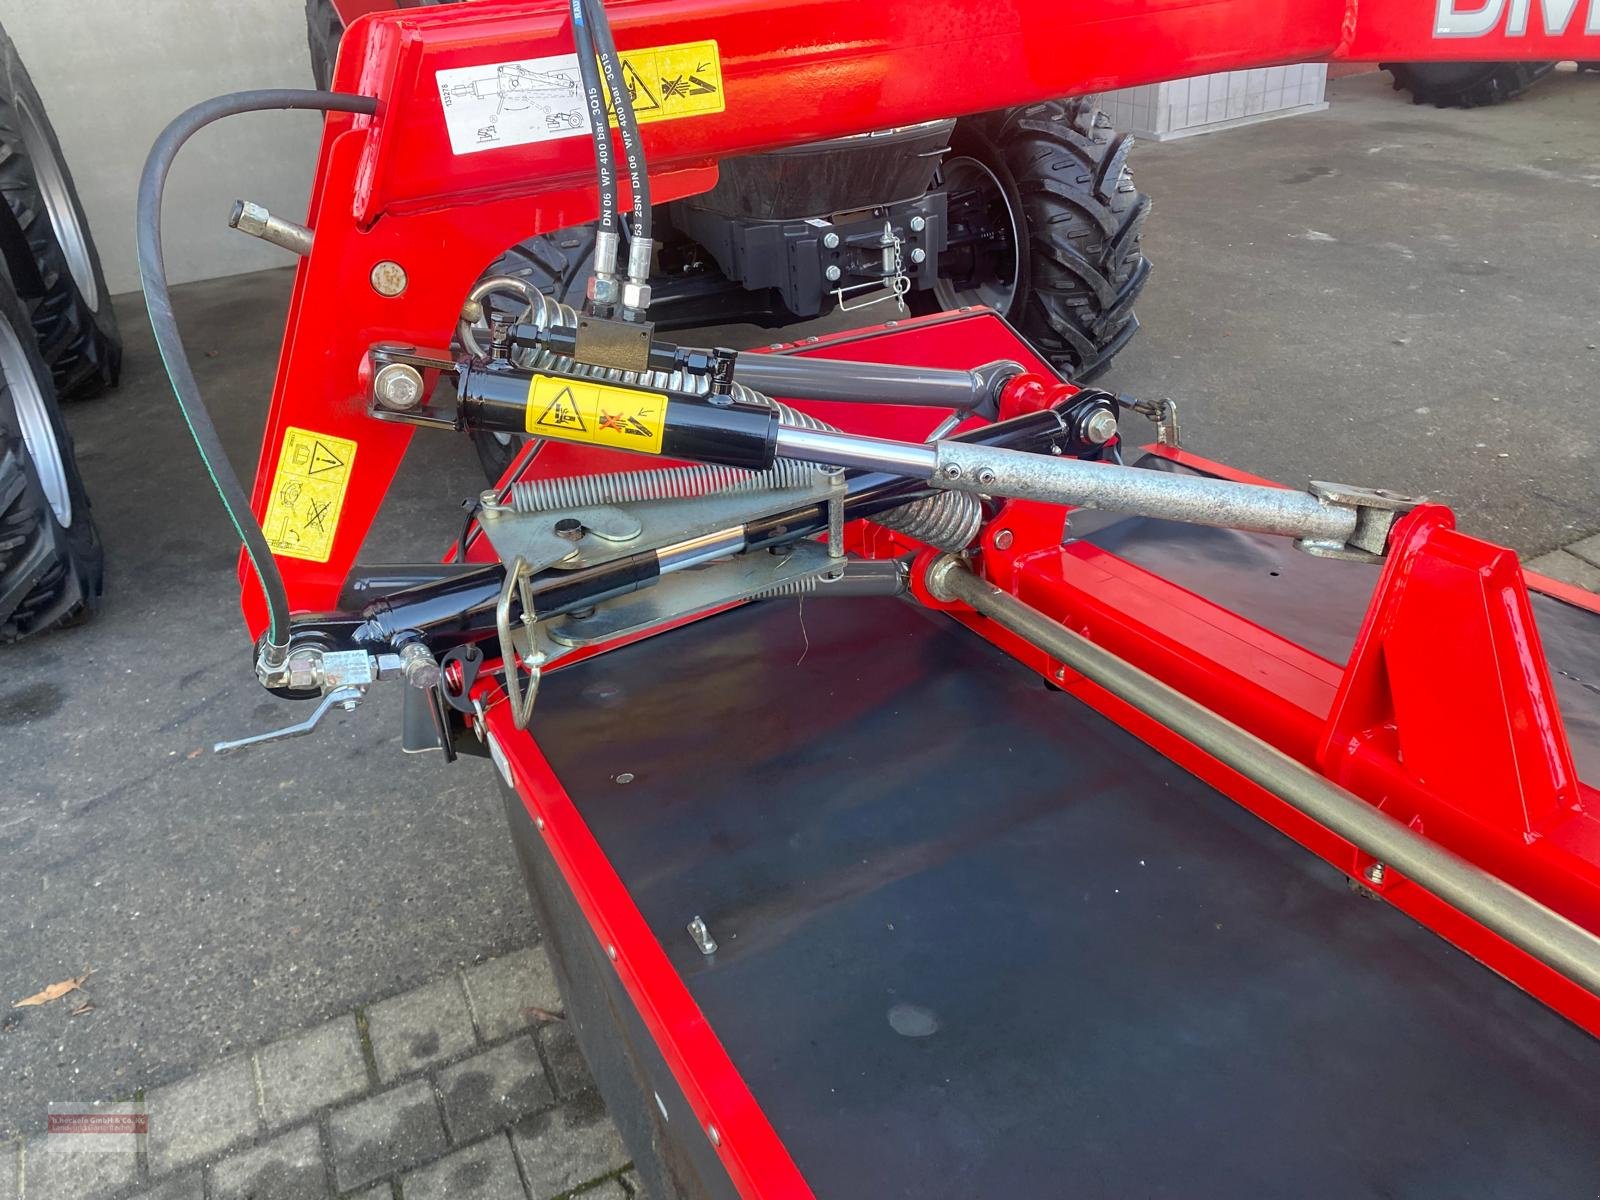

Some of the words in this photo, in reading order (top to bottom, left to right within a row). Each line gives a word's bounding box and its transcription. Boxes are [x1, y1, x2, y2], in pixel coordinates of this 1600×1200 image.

[601, 53, 615, 81] 3Q15
[588, 87, 601, 116] 3Q15
[611, 86, 621, 105] bar
[616, 106, 627, 127] 400
[596, 122, 605, 140] bar
[622, 130, 632, 149] WP
[599, 143, 608, 164] 400
[628, 155, 637, 169] 06
[601, 167, 610, 186] WP
[631, 172, 640, 189] DN
[603, 193, 611, 207] 06
[634, 195, 642, 218] 2SN
[603, 209, 612, 226] DN
[634, 223, 642, 236] 53
